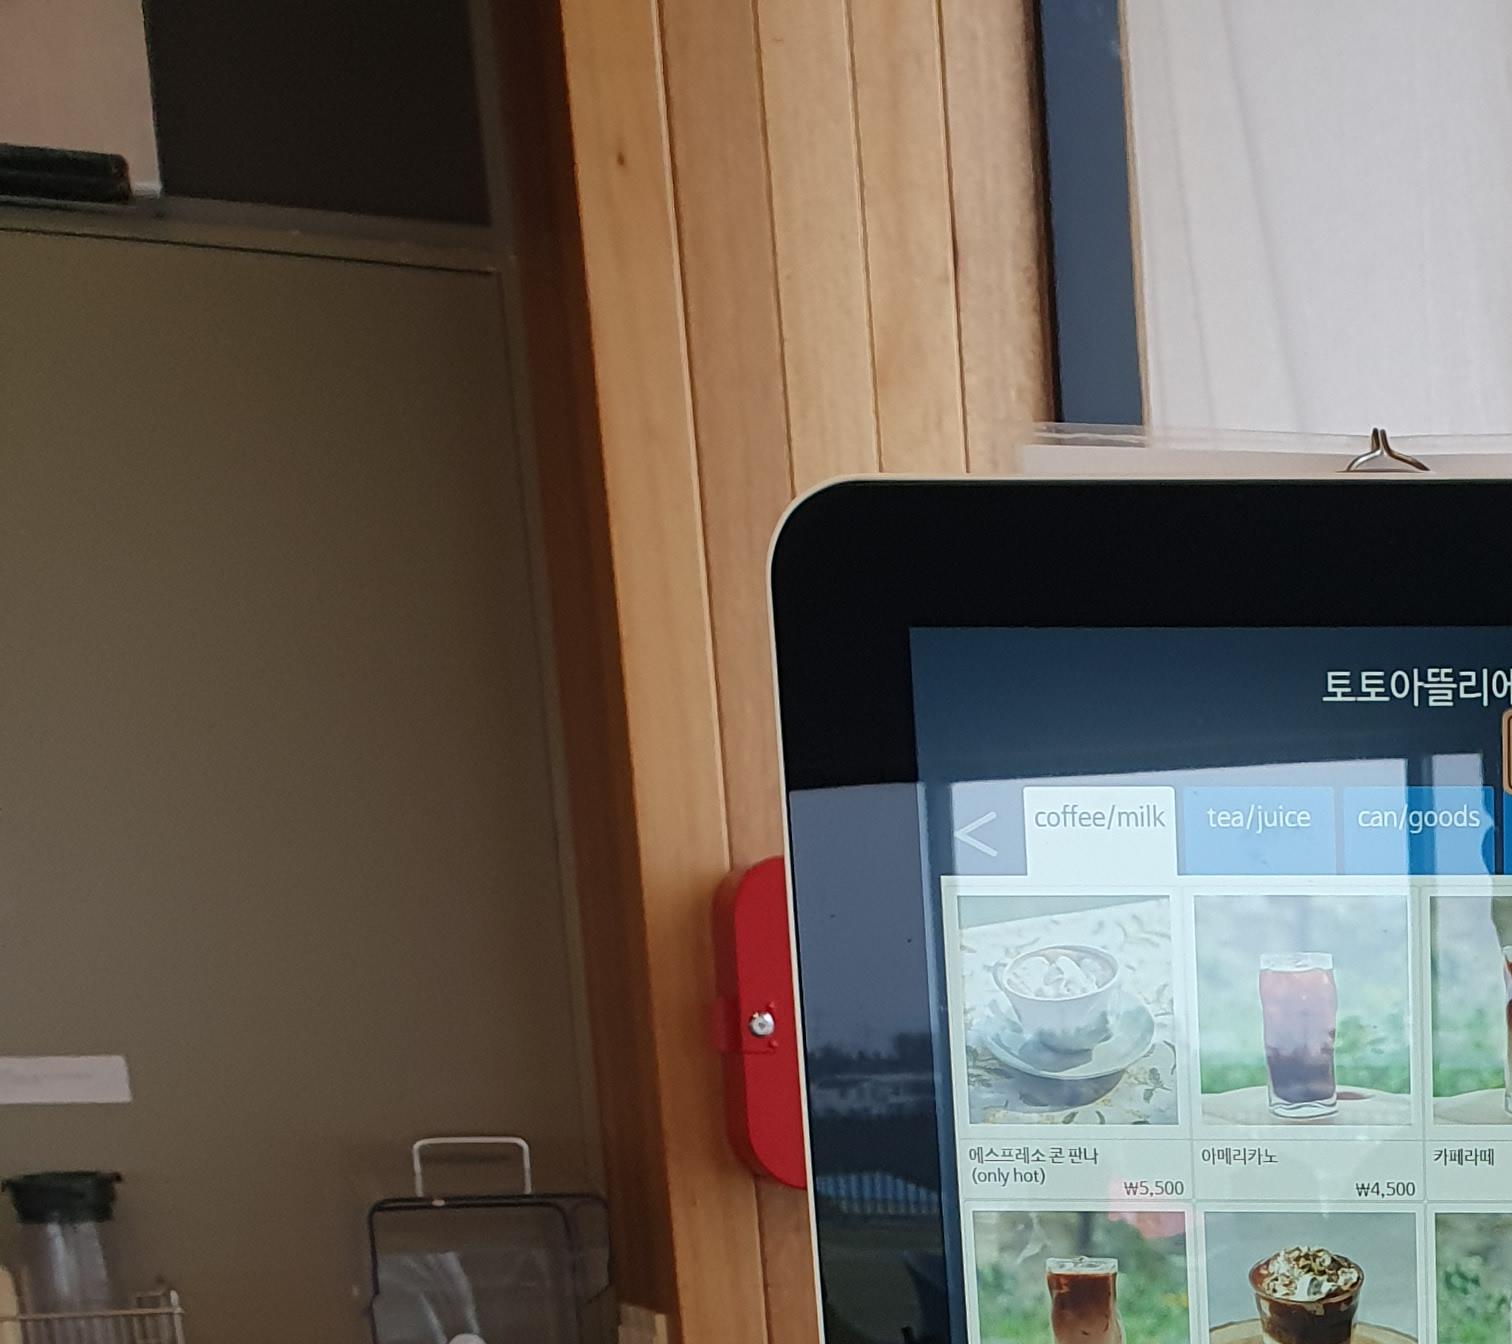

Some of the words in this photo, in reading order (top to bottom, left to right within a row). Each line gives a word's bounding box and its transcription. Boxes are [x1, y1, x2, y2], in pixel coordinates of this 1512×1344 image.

[1035, 805, 1165, 830] coffee/milk
[1207, 804, 1311, 833] tea/juice
[1357, 804, 1481, 834] can/goods
[969, 1147, 1046, 1164] 에스프레소
[1049, 1148, 1064, 1163] 콘
[1069, 1147, 1098, 1164] 판나
[1202, 1148, 1278, 1165] 아메리카노
[1434, 1148, 1494, 1166] 카페라떼
[972, 1168, 1009, 1187] (only
[1014, 1168, 1045, 1185] hot)
